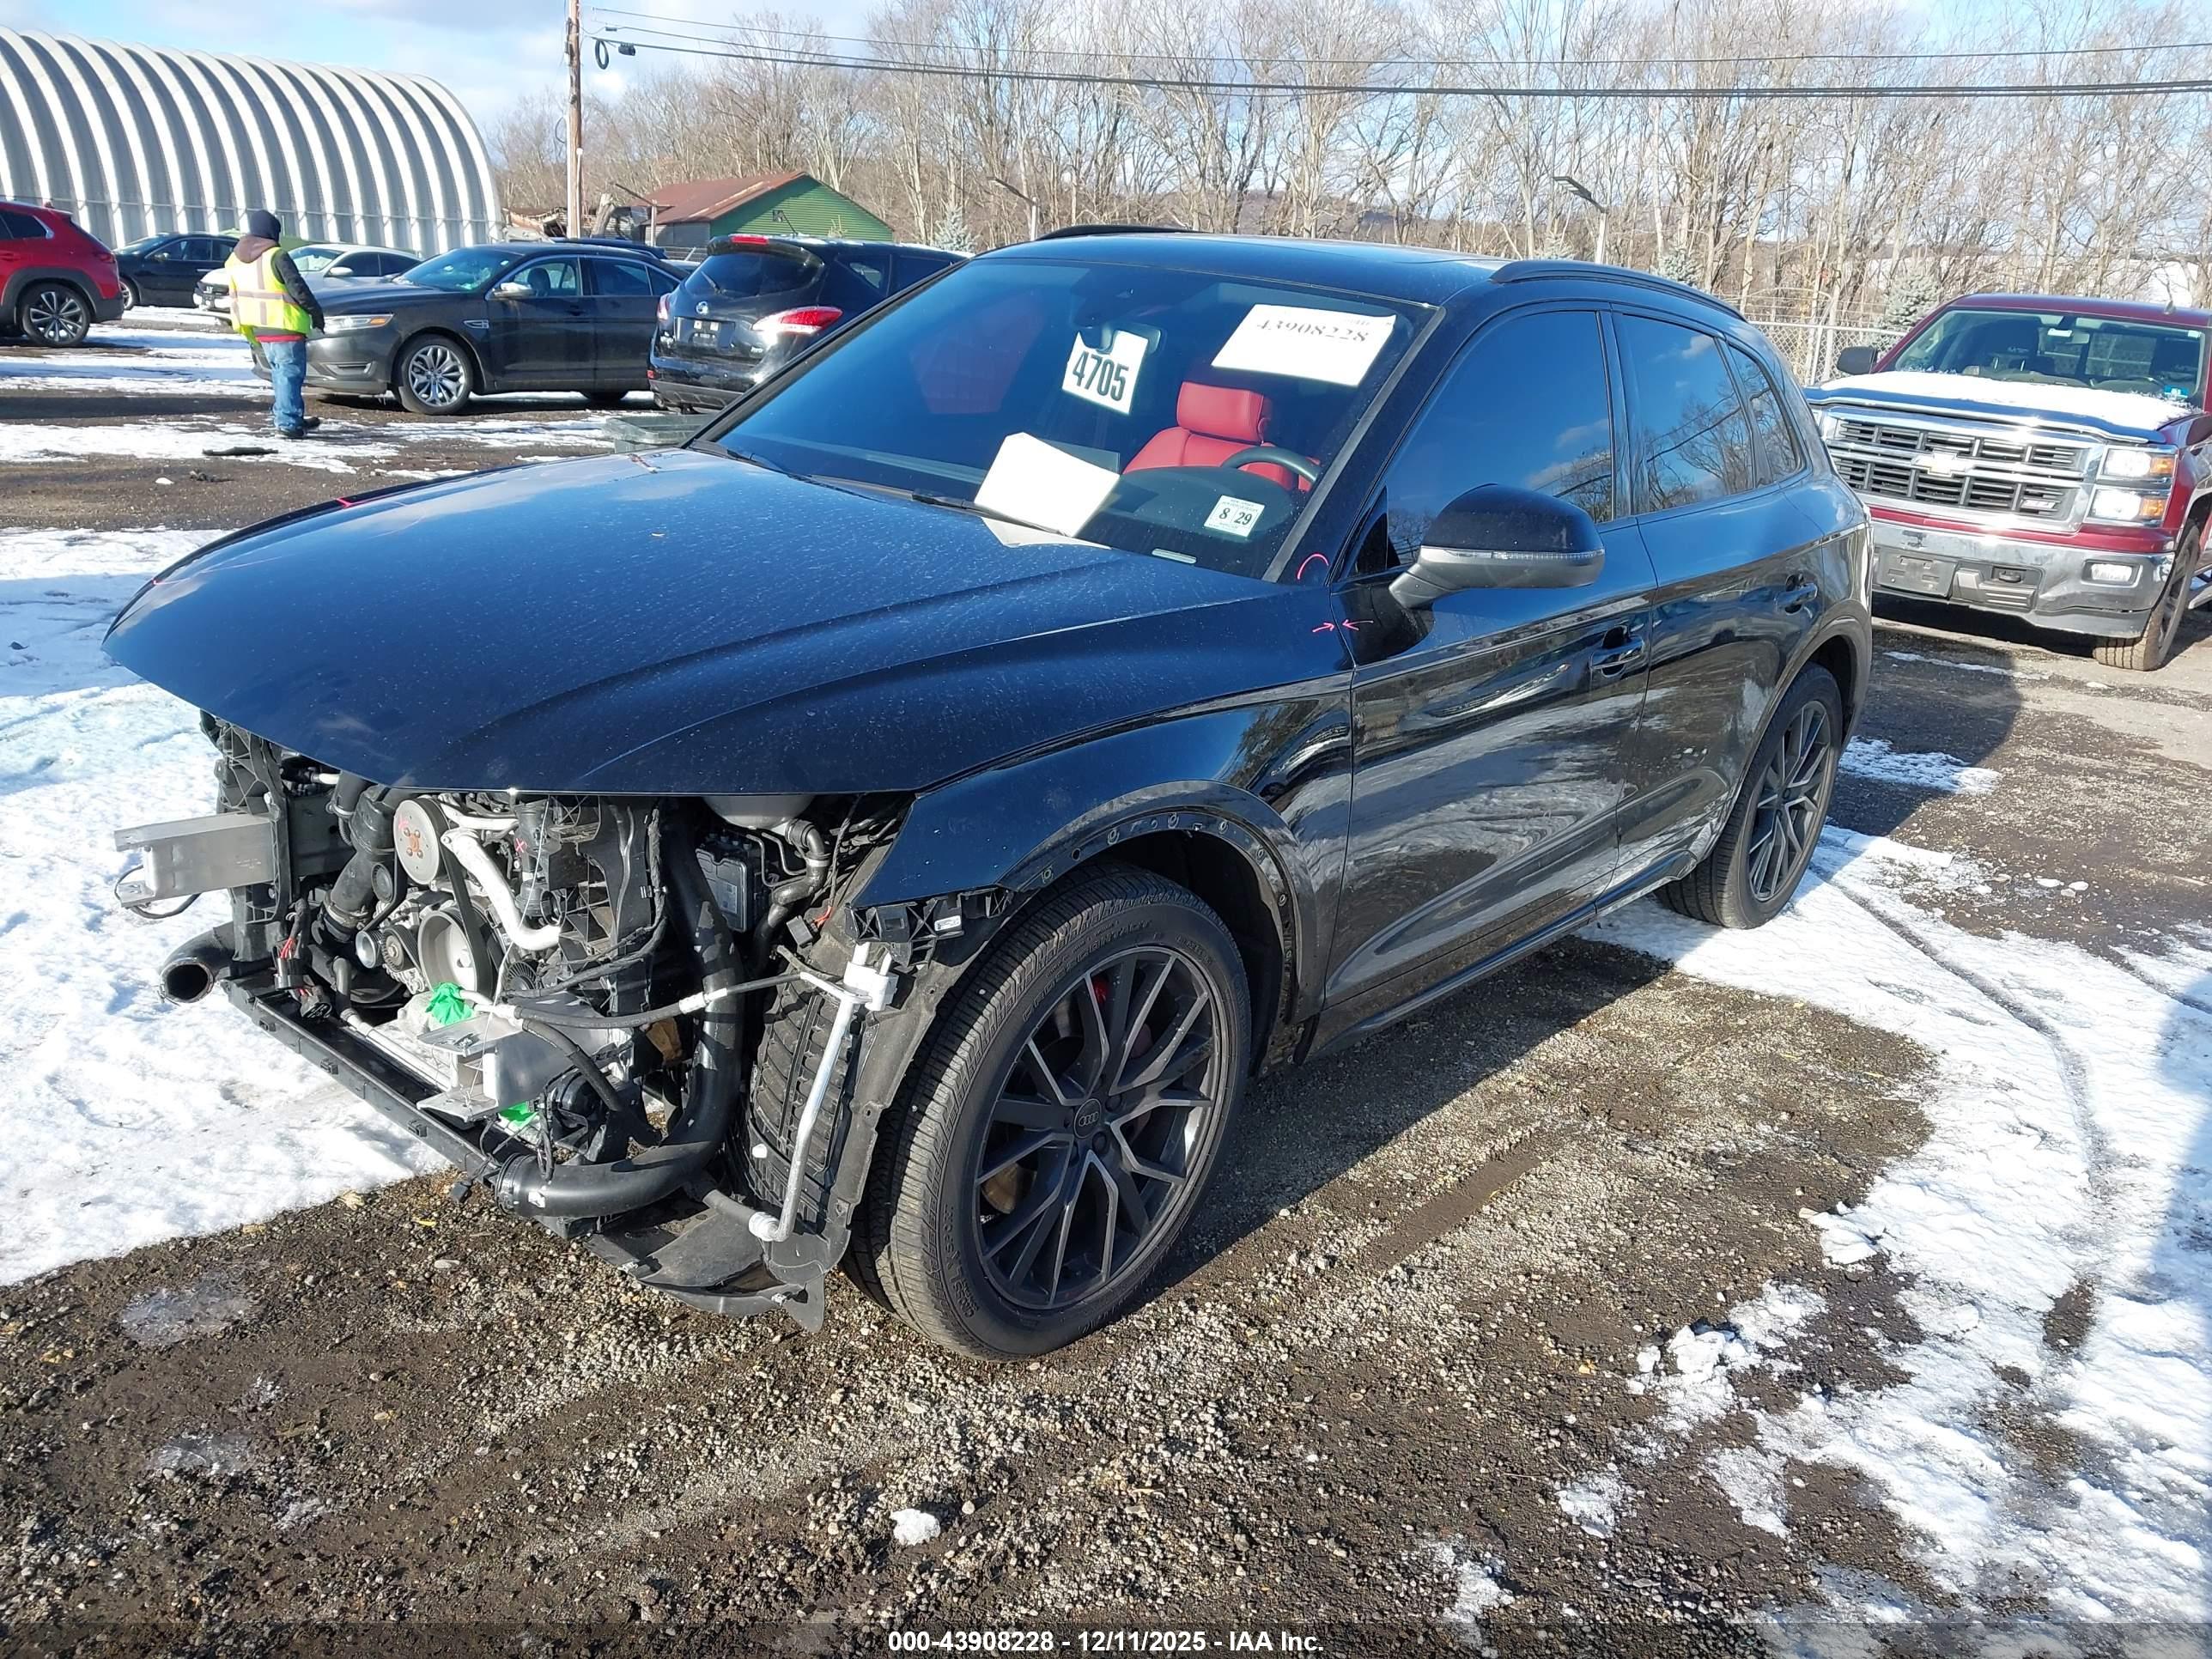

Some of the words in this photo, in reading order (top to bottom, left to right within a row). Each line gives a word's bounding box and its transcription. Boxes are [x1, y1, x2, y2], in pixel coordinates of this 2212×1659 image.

[1256, 319, 1369, 343] 43908228
[1073, 351, 1129, 401] 4705
[1218, 507, 1231, 520] 8
[1234, 512, 1253, 526] 29
